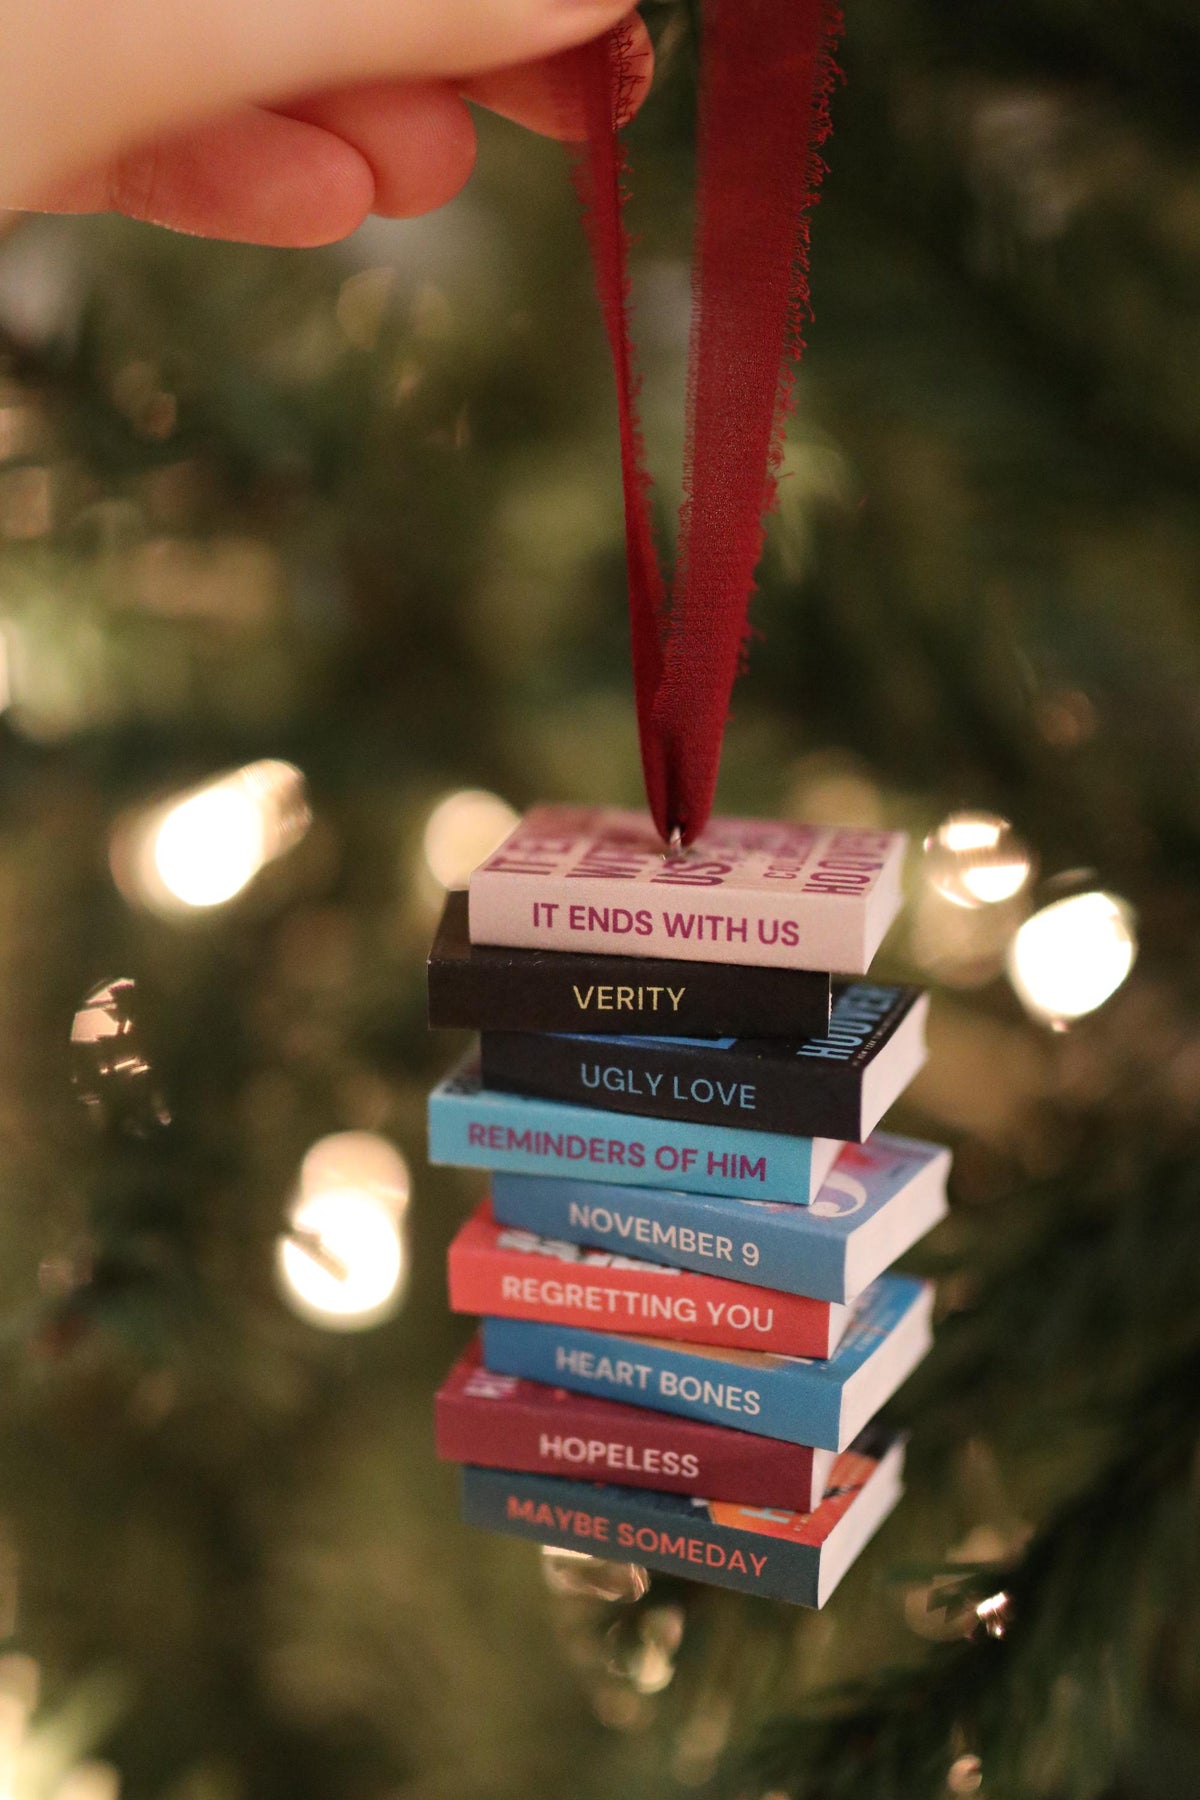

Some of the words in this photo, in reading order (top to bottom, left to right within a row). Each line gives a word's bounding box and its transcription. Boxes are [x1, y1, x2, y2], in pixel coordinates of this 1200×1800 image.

[533, 902, 559, 928] IT
[570, 905, 653, 936] ENDS
[662, 912, 747, 943] WITH
[759, 919, 800, 946] US
[573, 985, 686, 1011] VERITY
[581, 1063, 664, 1096] UGLY
[673, 1075, 756, 1110] LOVE
[468, 1122, 645, 1168] REMINDERS
[655, 1145, 698, 1172] OF
[707, 1152, 767, 1182] HIM
[569, 1202, 733, 1260] NOVEMBER
[742, 1242, 760, 1267] 9
[502, 1276, 697, 1322] REGRETTING
[706, 1302, 774, 1332] YOU
[556, 1346, 653, 1390] HEART
[659, 1371, 761, 1415] BONES
[540, 1434, 699, 1478] HOPELESS
[507, 1496, 609, 1542] MAYBE
[618, 1522, 768, 1577] SOMEDAY
